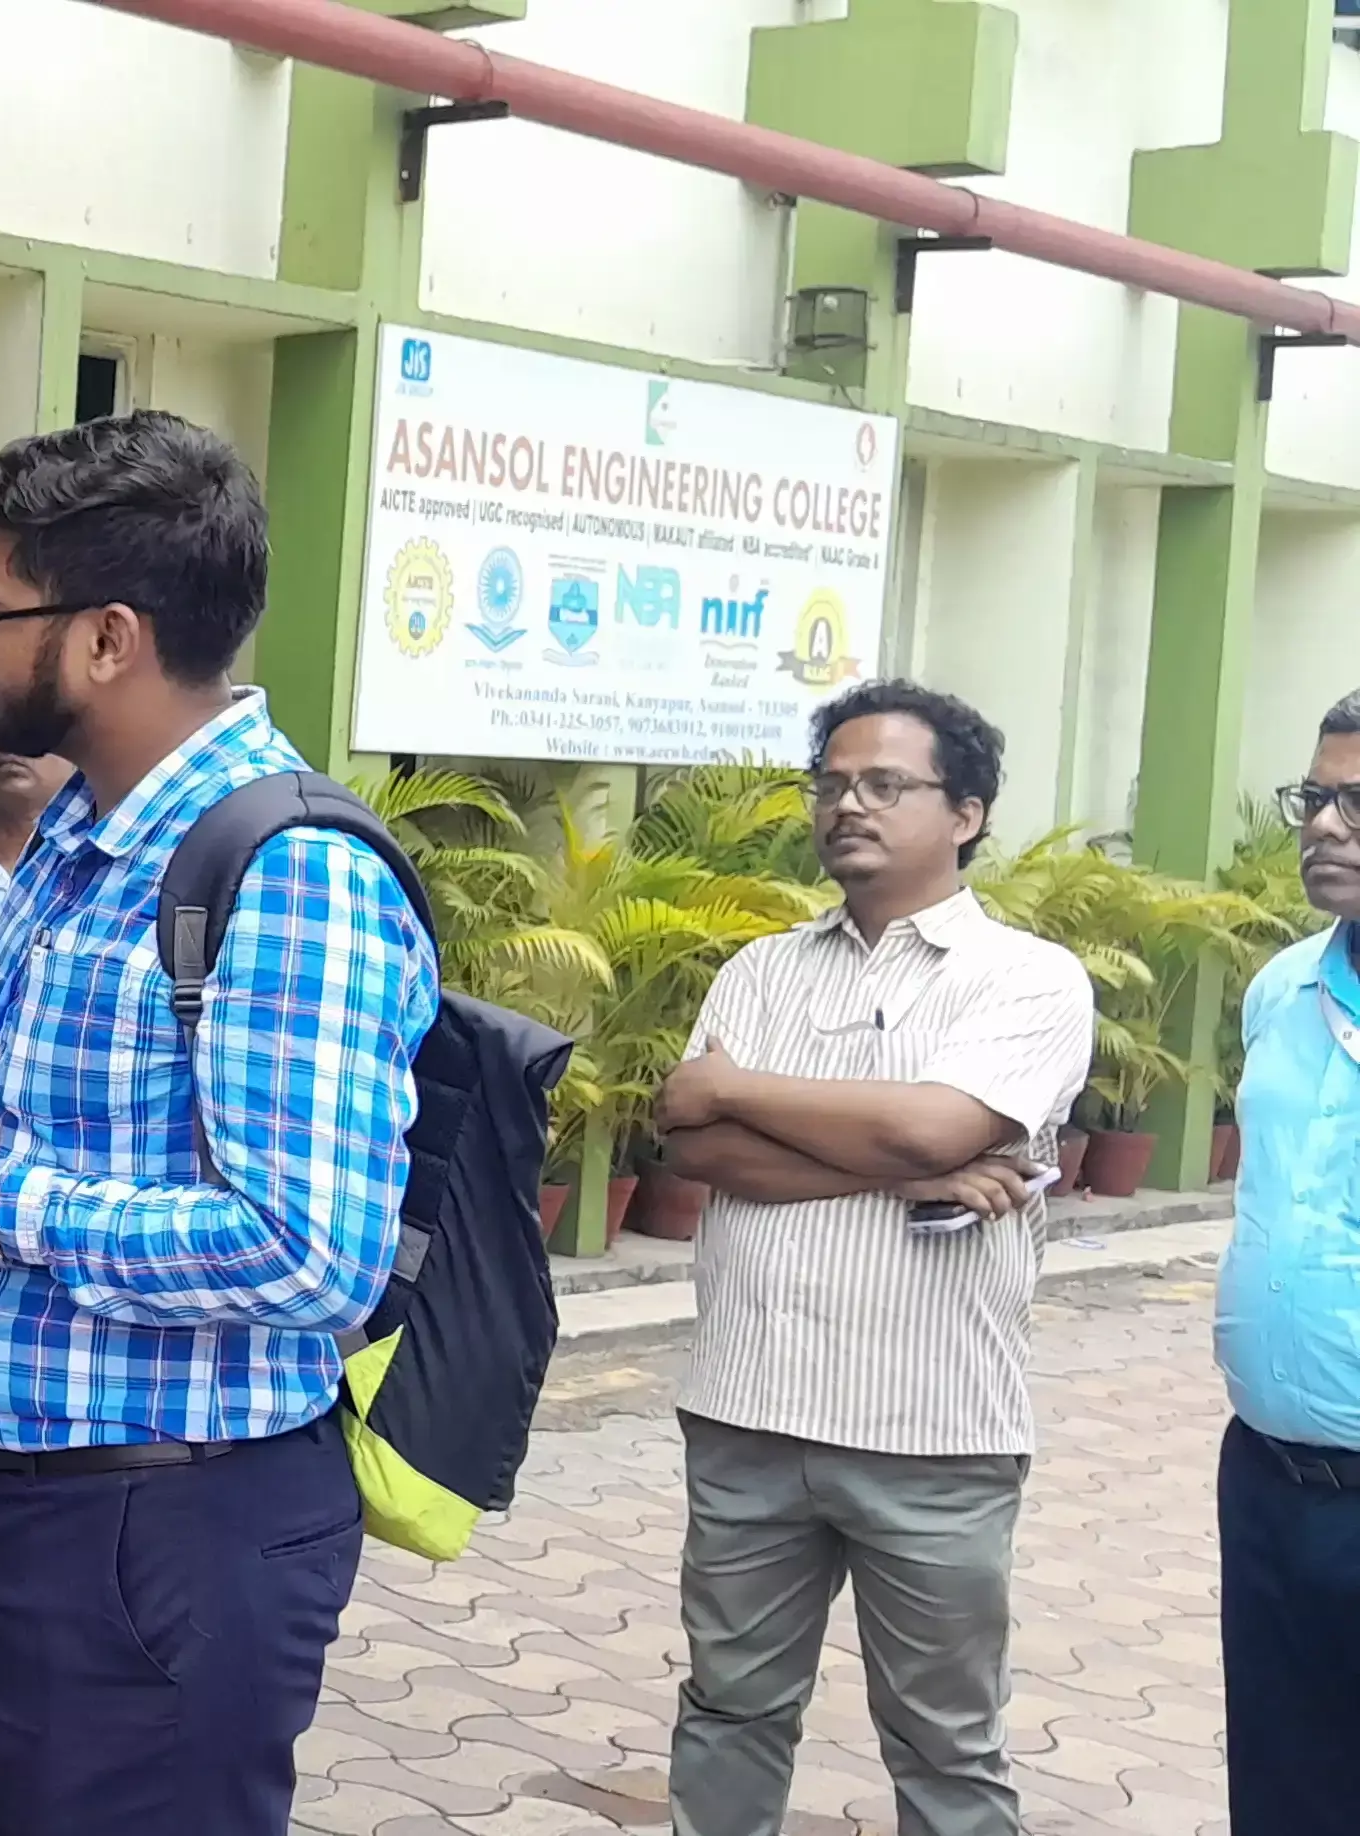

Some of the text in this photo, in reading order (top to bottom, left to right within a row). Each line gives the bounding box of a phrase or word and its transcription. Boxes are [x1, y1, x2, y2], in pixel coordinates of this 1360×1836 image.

[380, 487, 416, 513] AICTE
[418, 497, 470, 520] approved
[480, 500, 503, 524] UGC
[505, 508, 564, 533] recognised
[386, 418, 882, 539] ASANSOL ENGINEERING COLLEGE
